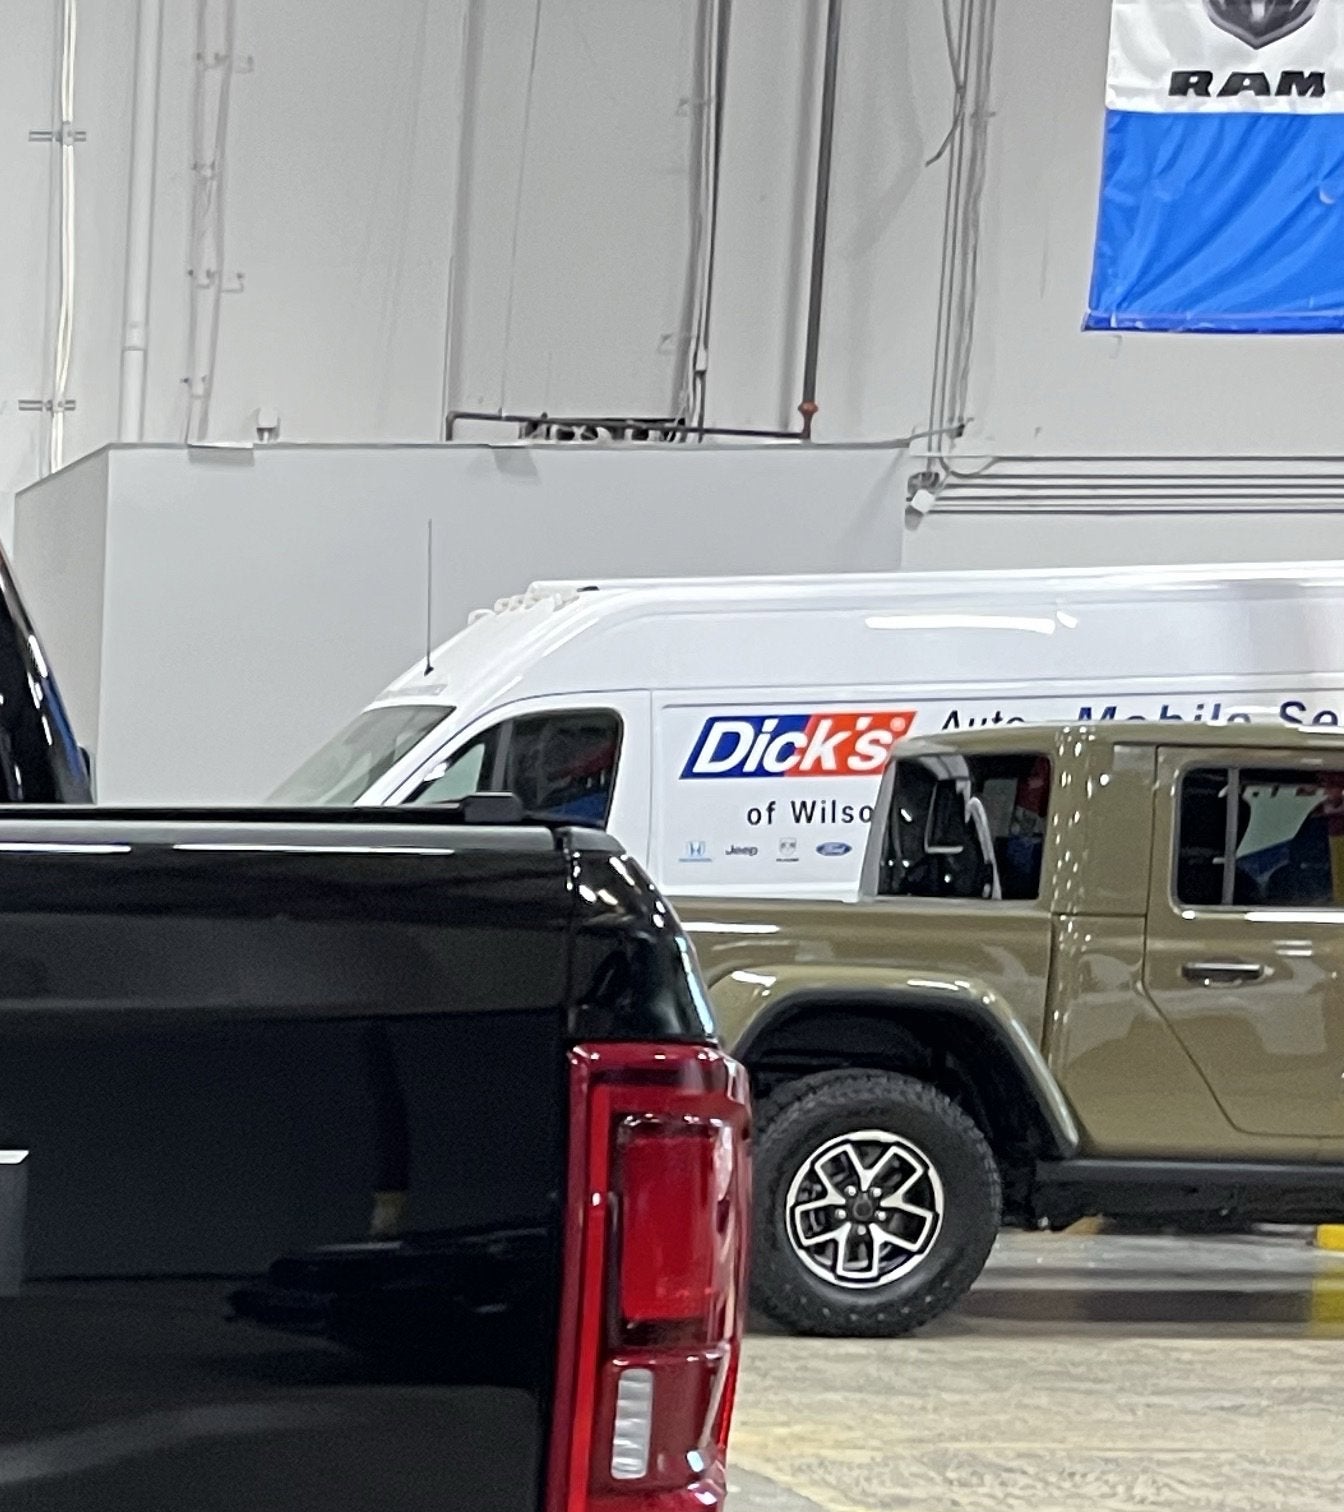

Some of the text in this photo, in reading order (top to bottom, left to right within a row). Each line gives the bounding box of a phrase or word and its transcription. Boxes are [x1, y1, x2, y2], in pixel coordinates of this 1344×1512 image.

[1168, 70, 1325, 98] RAM
[692, 714, 894, 774] Dick's
[747, 801, 776, 825] of
